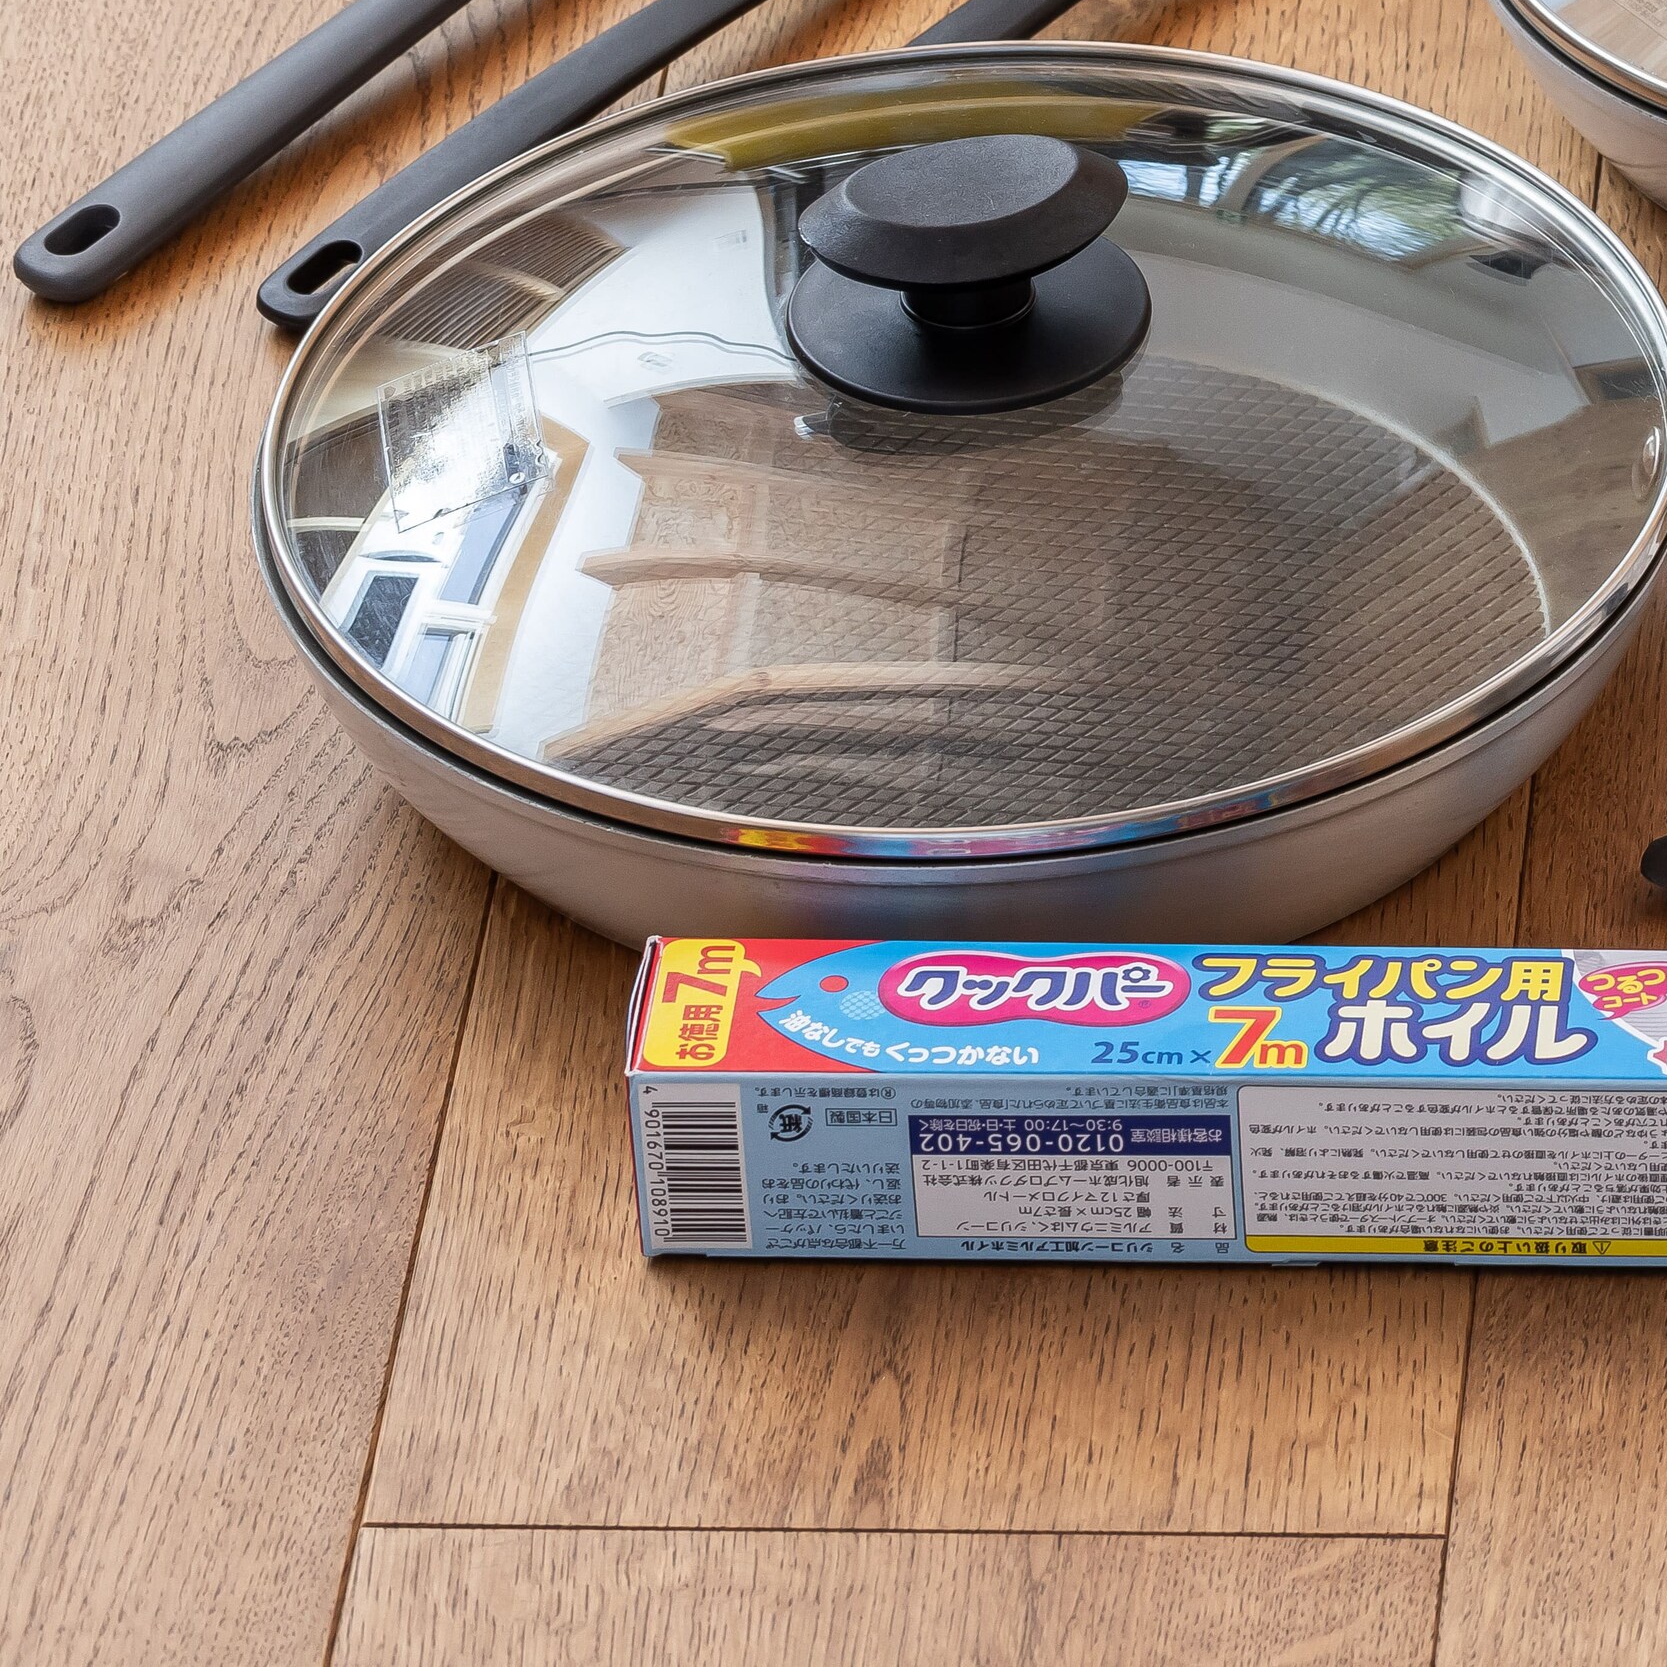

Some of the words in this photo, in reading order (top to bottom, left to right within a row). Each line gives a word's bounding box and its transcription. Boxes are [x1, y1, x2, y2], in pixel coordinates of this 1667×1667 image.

[1202, 955, 1562, 1001] フライパン用
[1602, 992, 1657, 1008] コート
[1329, 1001, 1587, 1061] ホイル
[919, 1133, 1124, 1153] 0120-065-402
[1131, 1128, 1222, 1143] お客様相談室
